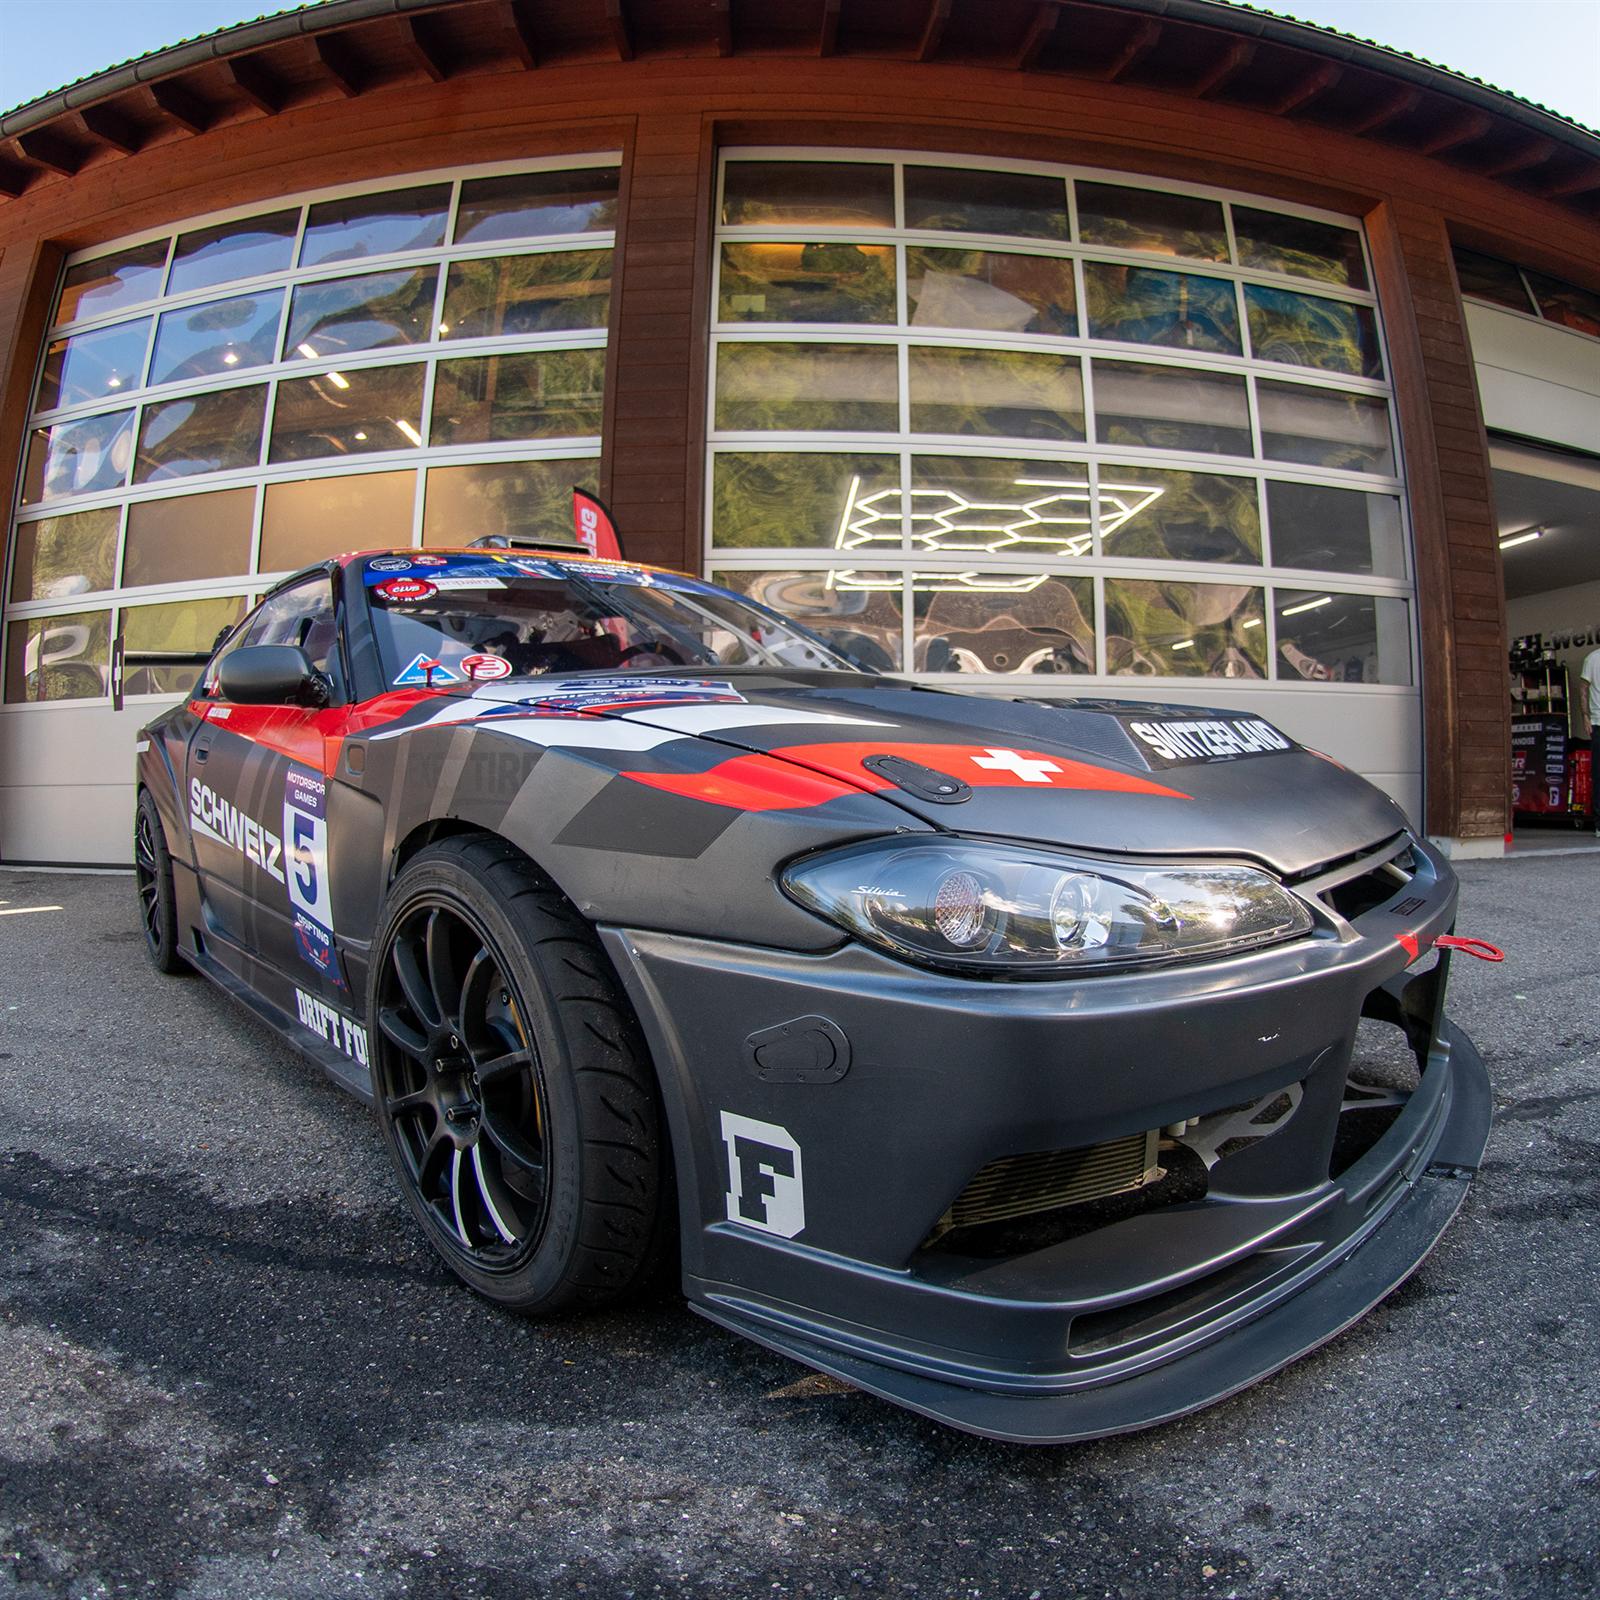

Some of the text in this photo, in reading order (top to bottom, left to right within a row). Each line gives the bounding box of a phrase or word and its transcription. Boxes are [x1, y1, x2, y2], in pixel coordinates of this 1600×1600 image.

[1130, 720, 1290, 759] SWITZERLAND
[295, 789, 317, 807] GAMES
[191, 777, 285, 884] SCHWEIZ
[294, 812, 317, 905] 5
[853, 885, 904, 897] Silvia
[296, 912, 329, 946] DRIFTING
[295, 988, 340, 1048] DRIFT
[727, 1119, 801, 1231] F
